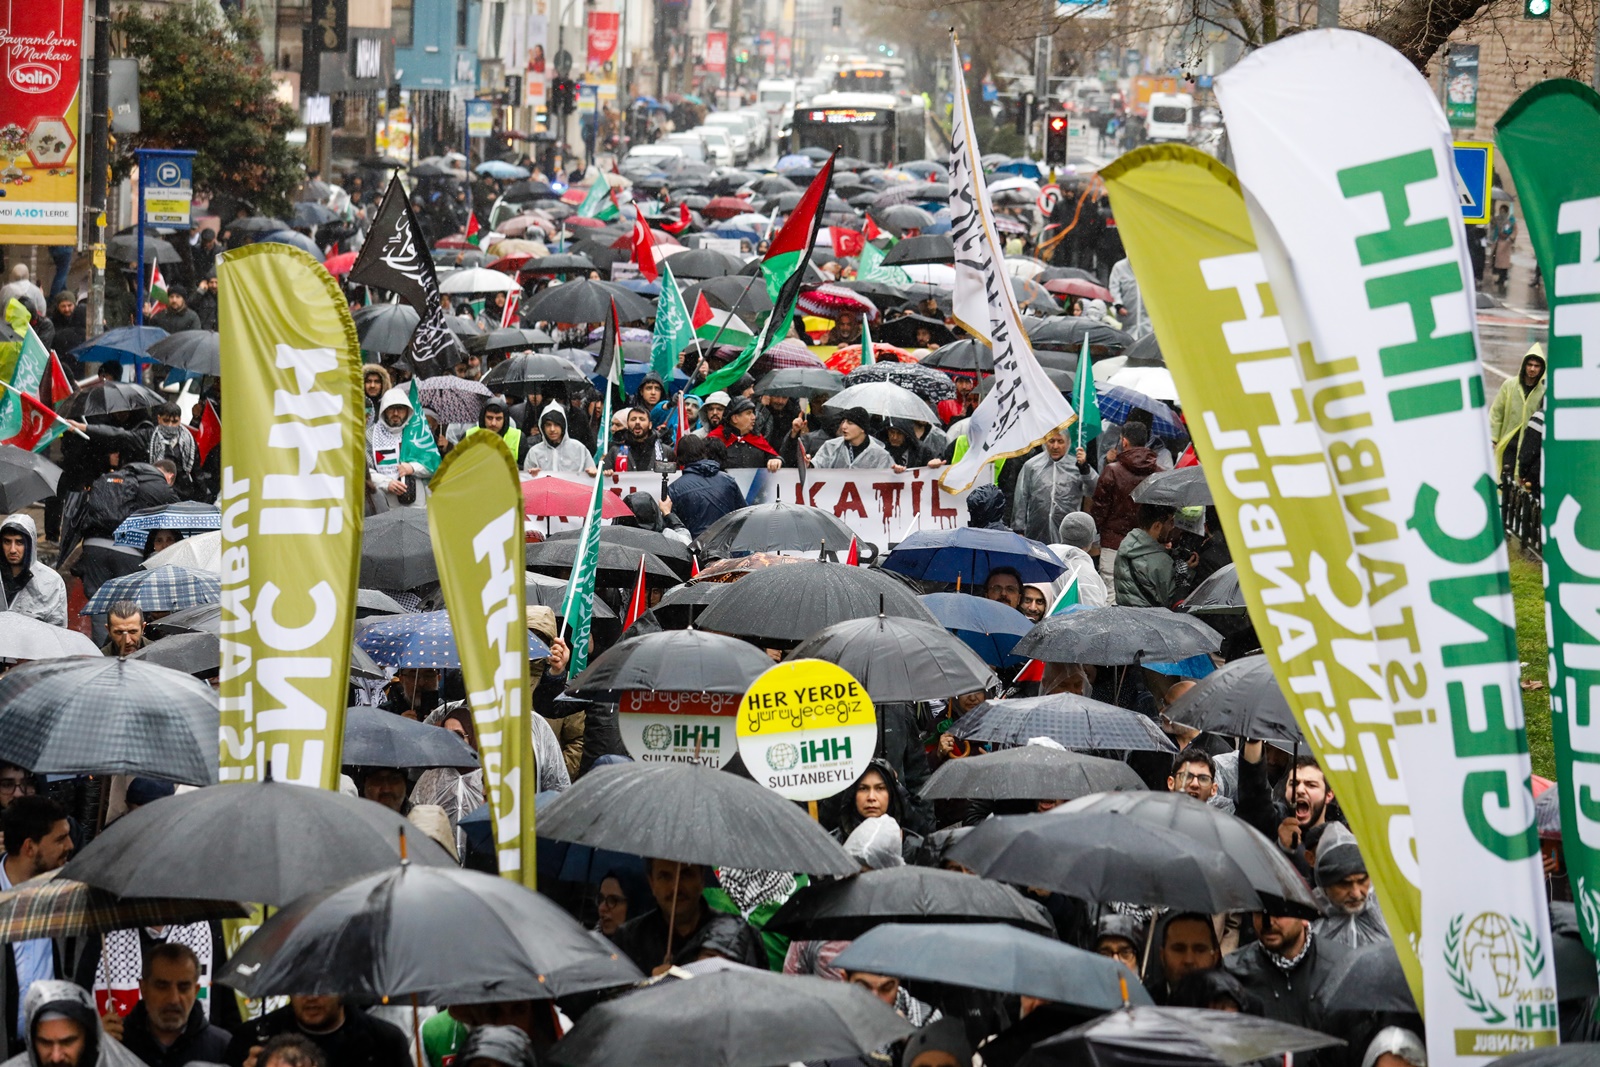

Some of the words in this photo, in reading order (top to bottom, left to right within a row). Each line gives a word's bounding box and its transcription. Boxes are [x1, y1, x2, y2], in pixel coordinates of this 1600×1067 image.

[12, 45, 72, 62] Markası
[16, 69, 52, 85] balin
[795, 469, 957, 530] KATİL
[748, 691, 788, 711] HER
[794, 681, 858, 704] YERDE
[748, 700, 862, 733] yürüyeceğiz
